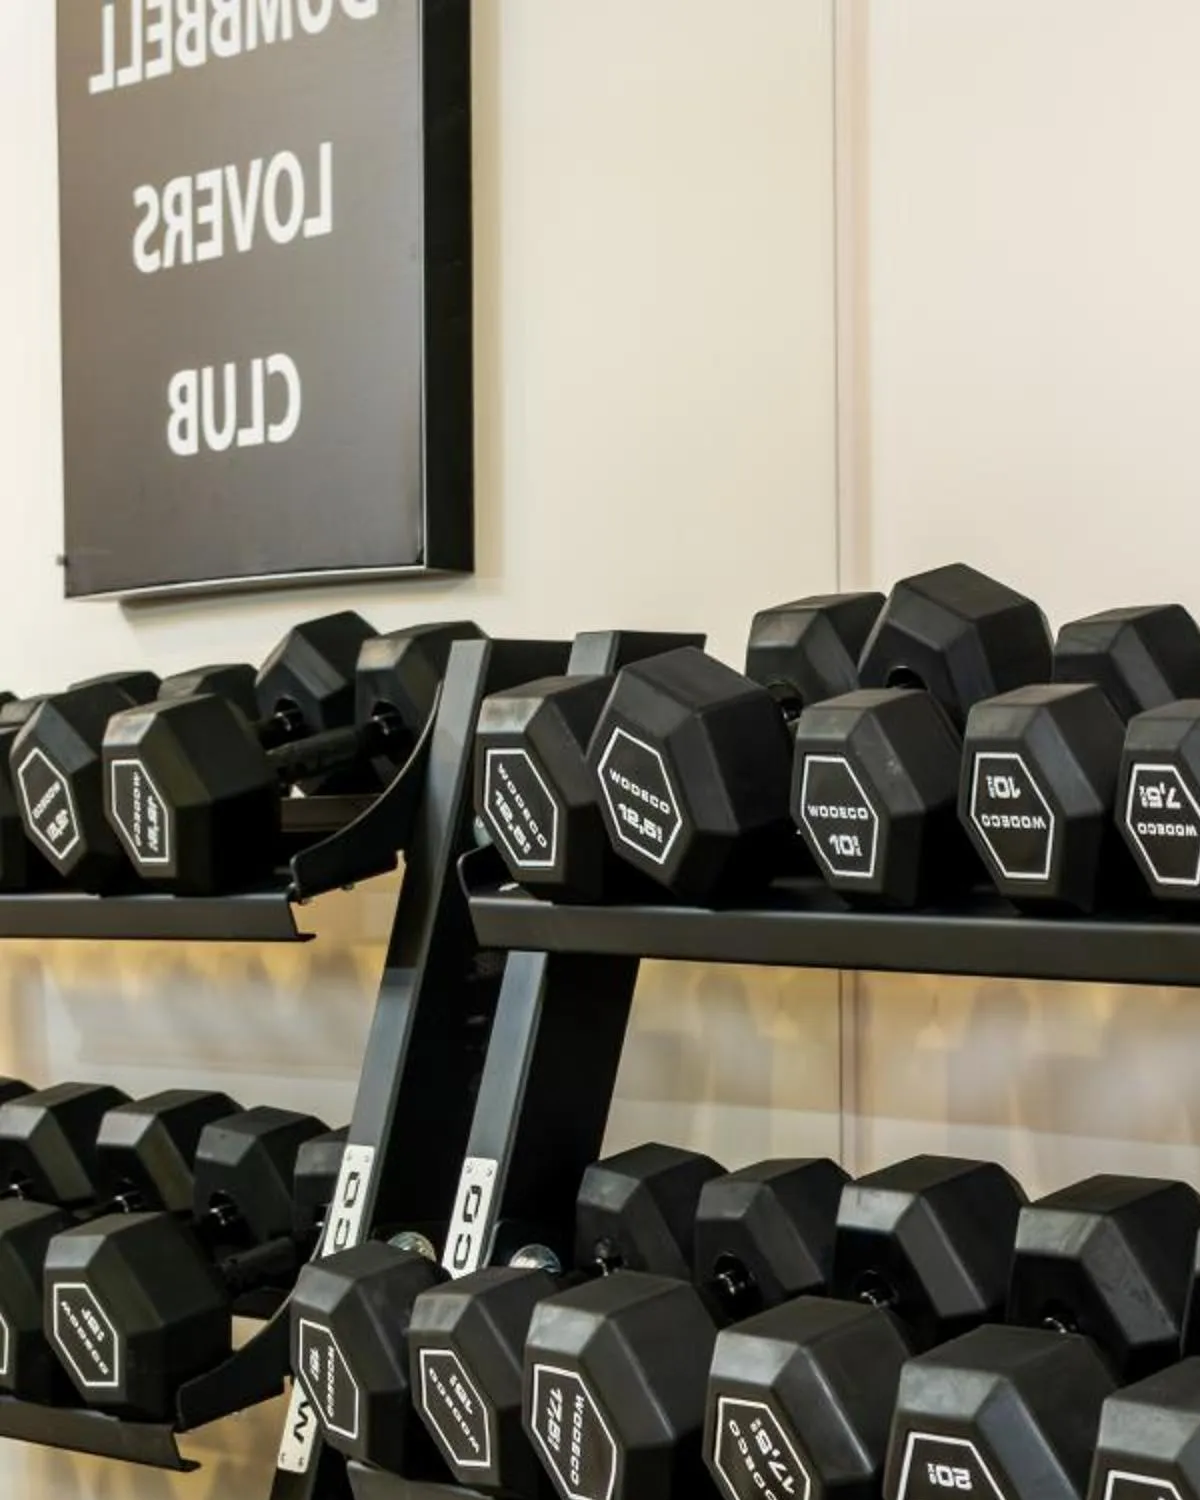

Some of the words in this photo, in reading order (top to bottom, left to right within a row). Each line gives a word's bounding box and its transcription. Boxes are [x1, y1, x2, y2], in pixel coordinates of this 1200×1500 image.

[609, 767, 671, 815] WODECO
[807, 805, 869, 820] WODECO
[982, 813, 1047, 829] WODECO
[1137, 821, 1198, 838] WODECO
[570, 1395, 585, 1486] WODECO
